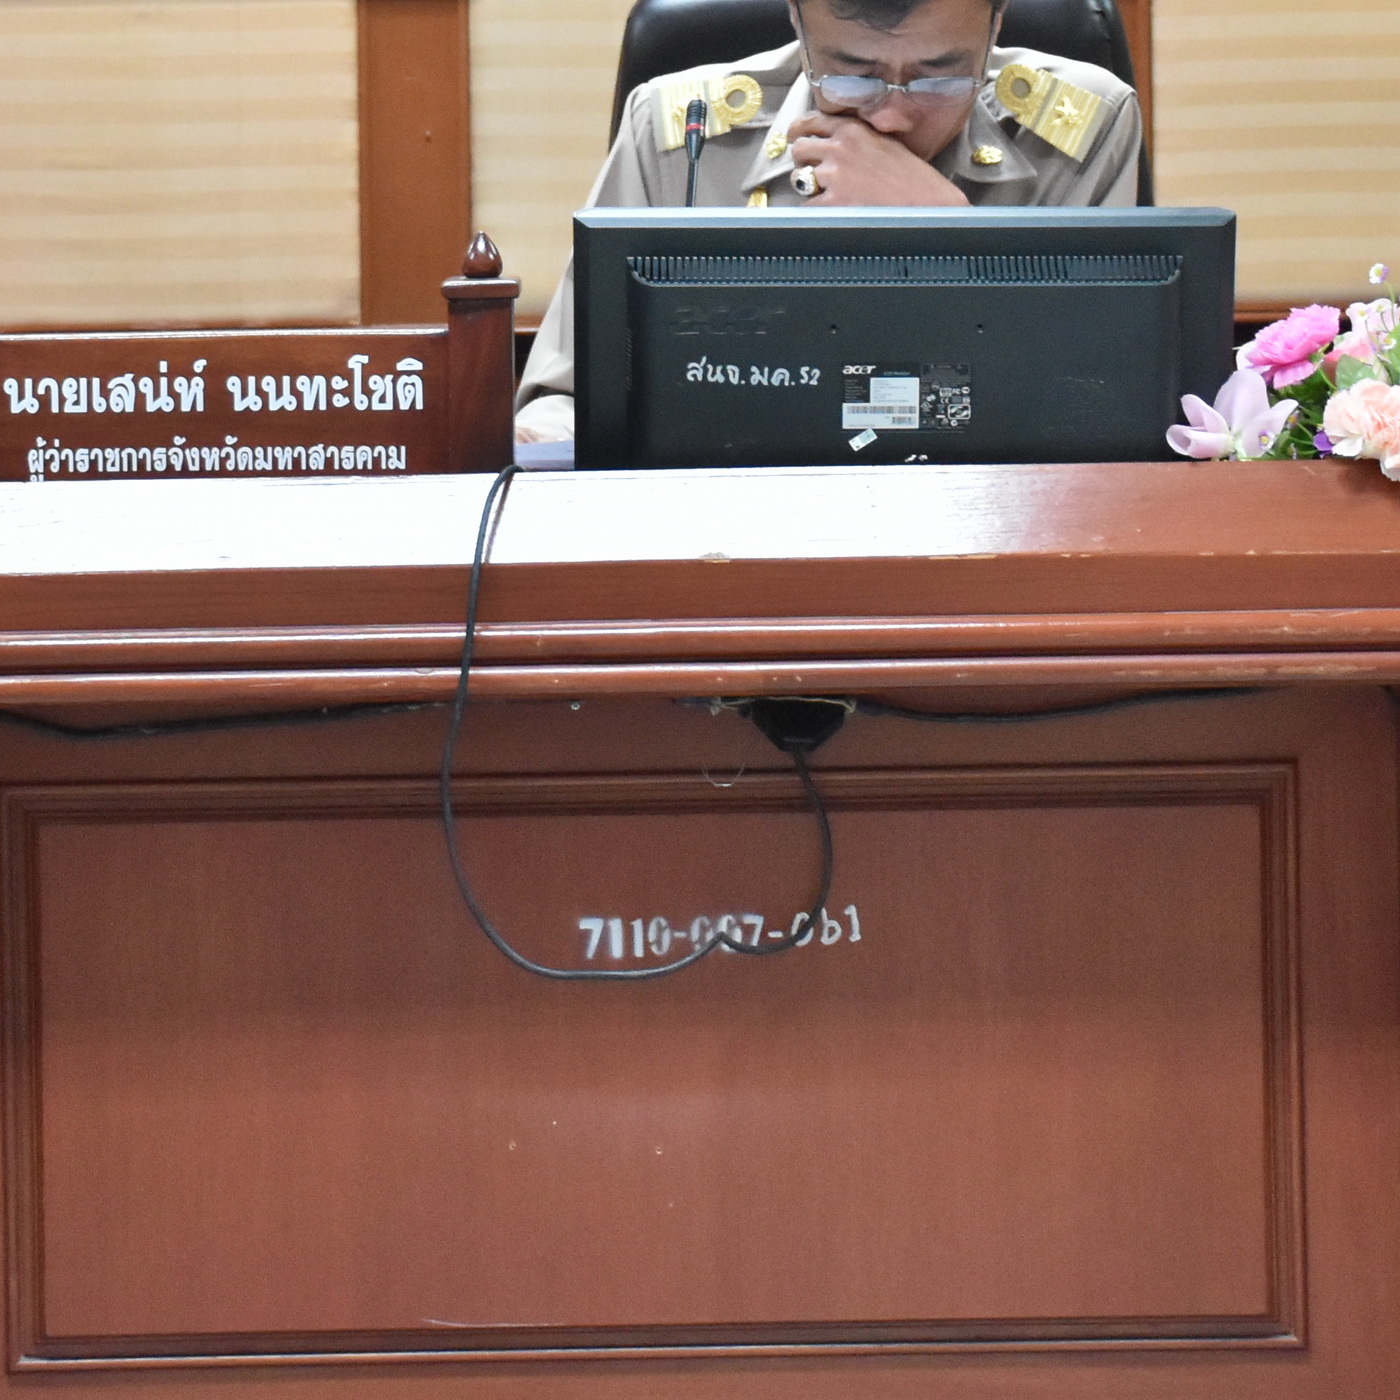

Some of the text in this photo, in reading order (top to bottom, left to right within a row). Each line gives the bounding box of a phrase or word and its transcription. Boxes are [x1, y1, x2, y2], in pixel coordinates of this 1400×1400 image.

[2, 352, 425, 415] นายเสน่ห์ นนทะโชติ
[842, 364, 877, 375] acer
[26, 434, 408, 482] ผู้ว่าราชการจังหวัดมหาสารคาม
